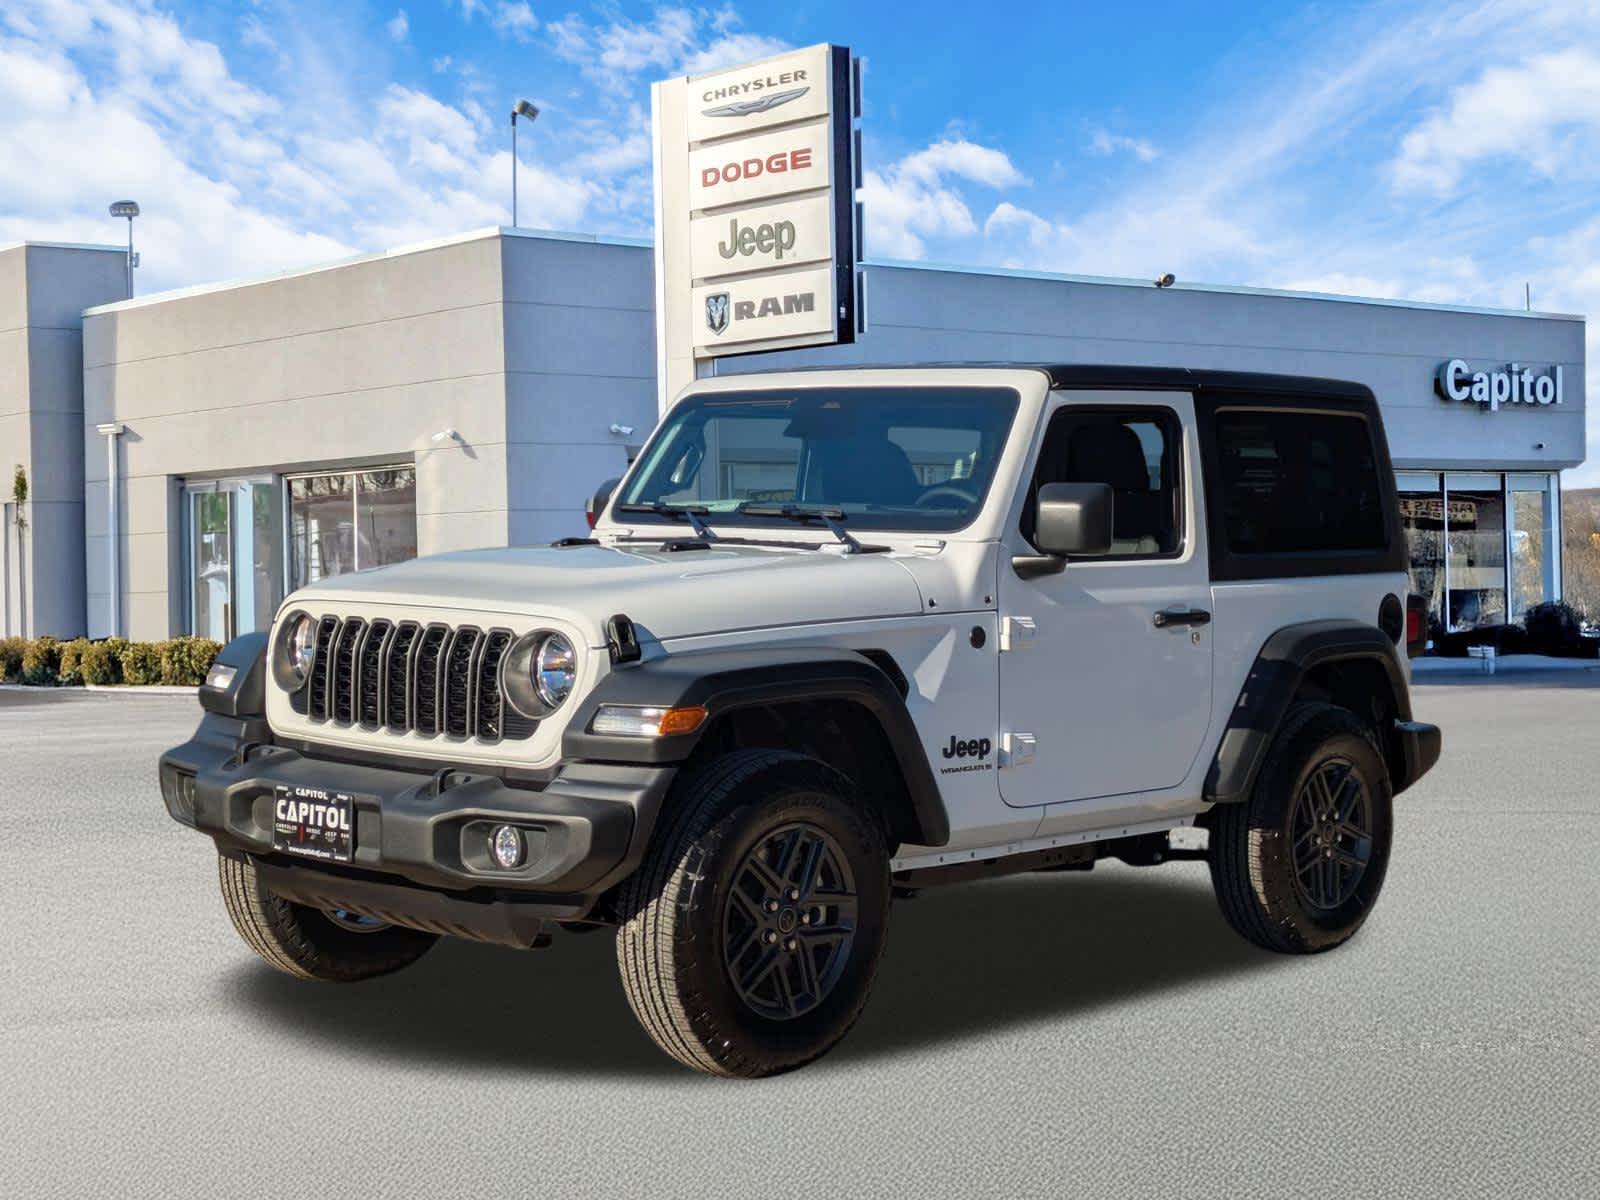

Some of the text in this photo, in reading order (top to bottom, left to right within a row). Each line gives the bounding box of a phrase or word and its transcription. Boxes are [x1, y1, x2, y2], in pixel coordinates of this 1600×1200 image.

[702, 70, 808, 103] CHRYSLER
[702, 148, 812, 188] DODGE
[718, 218, 796, 260] Jeep
[734, 292, 815, 321] RAM
[1446, 359, 1563, 411] Capitol
[942, 735, 991, 760] Jeep
[295, 787, 328, 800] CAPITOL
[276, 799, 350, 830] CAPITOL
